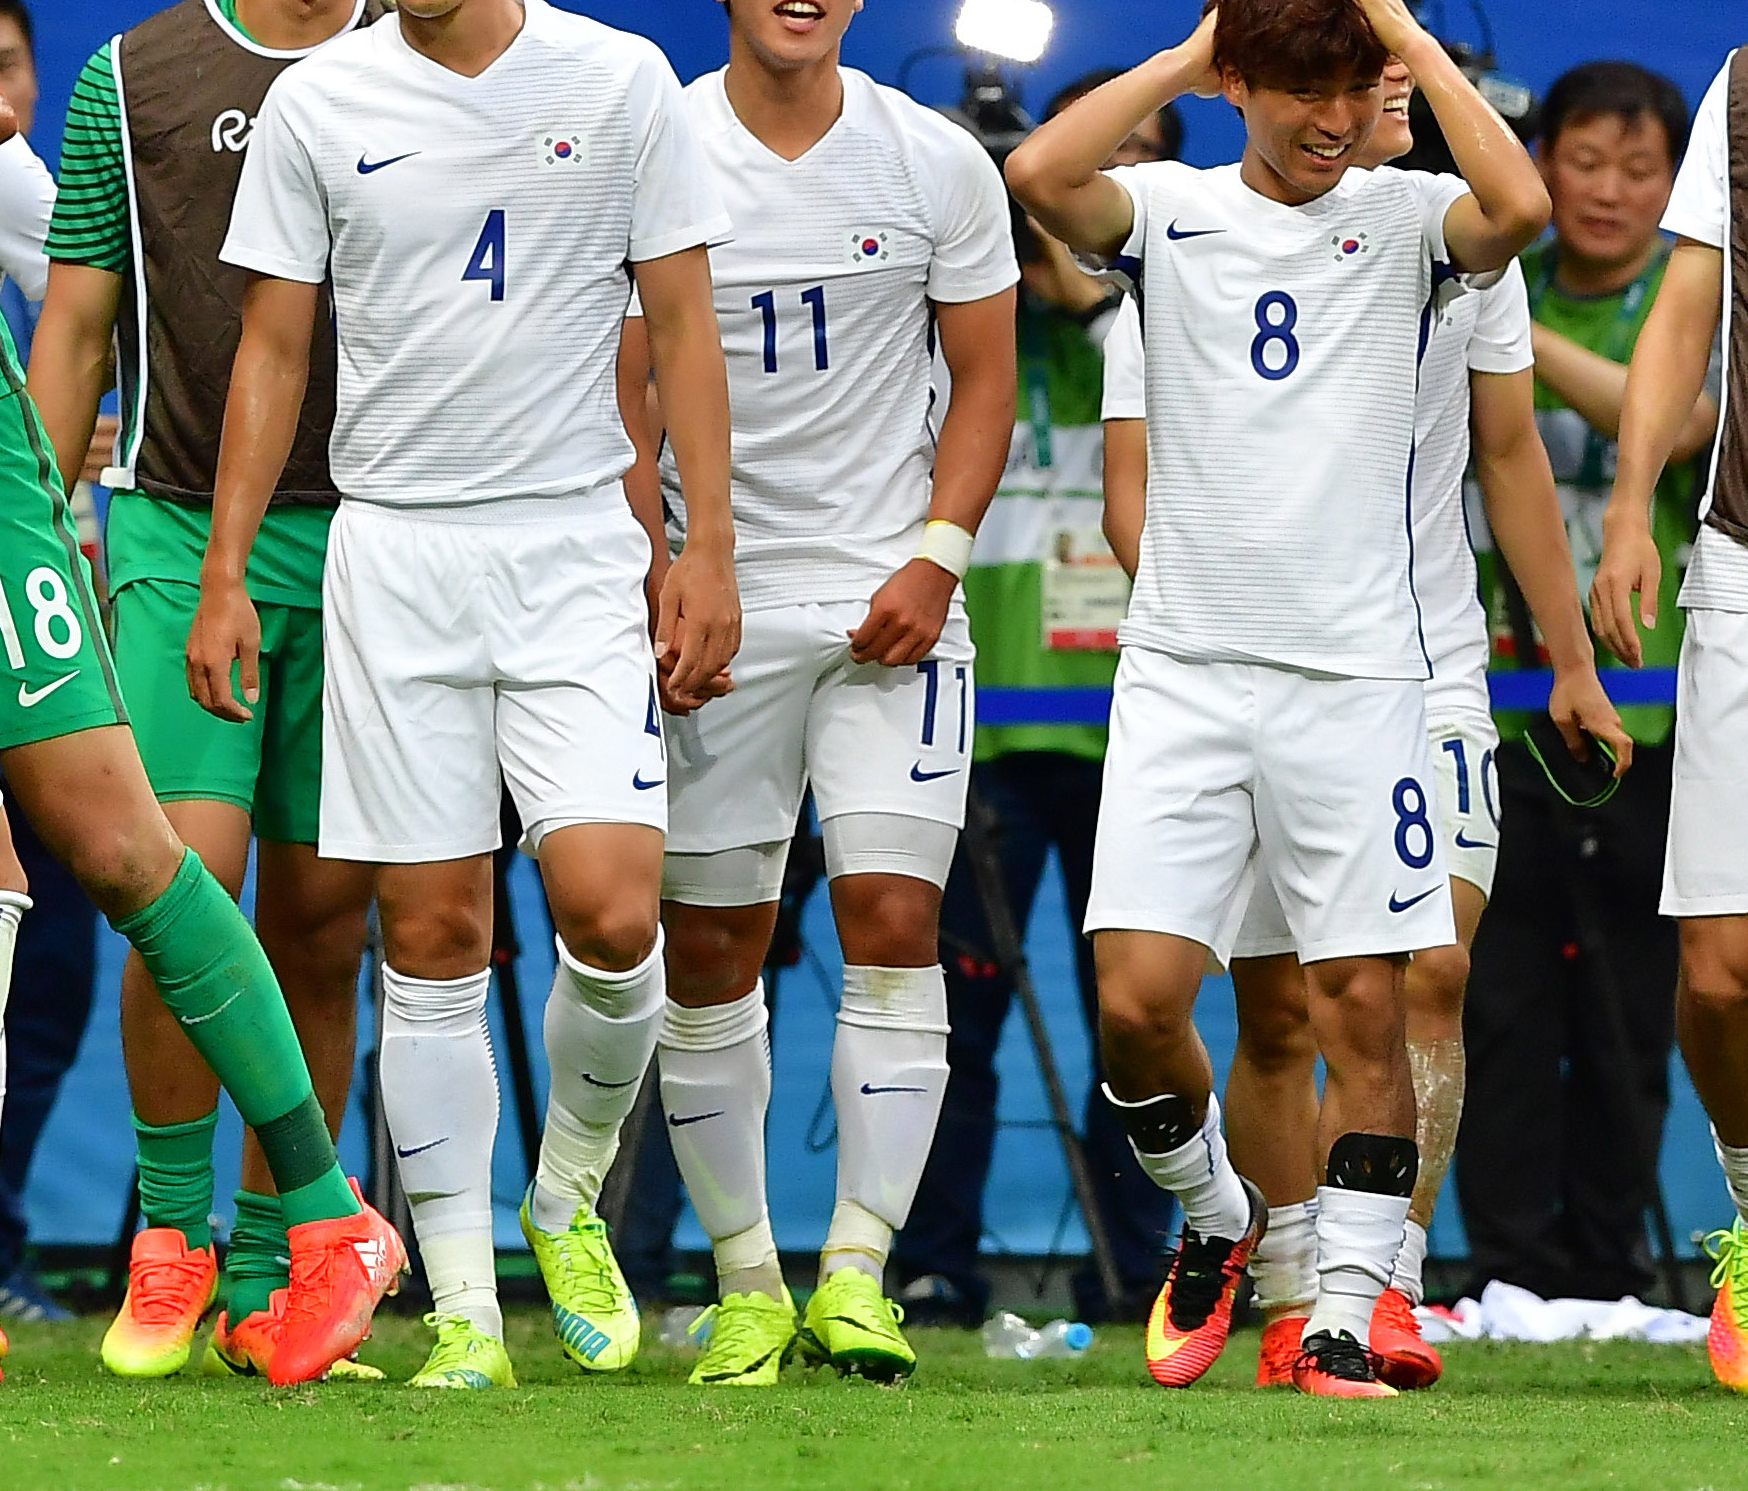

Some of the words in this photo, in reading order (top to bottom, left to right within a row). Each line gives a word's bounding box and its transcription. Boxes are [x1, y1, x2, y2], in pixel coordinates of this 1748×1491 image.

[461, 209, 506, 302] 4
[751, 285, 829, 374] 11
[1251, 290, 1300, 380] 8
[917, 660, 967, 754] 11
[1392, 776, 1434, 869] 8
